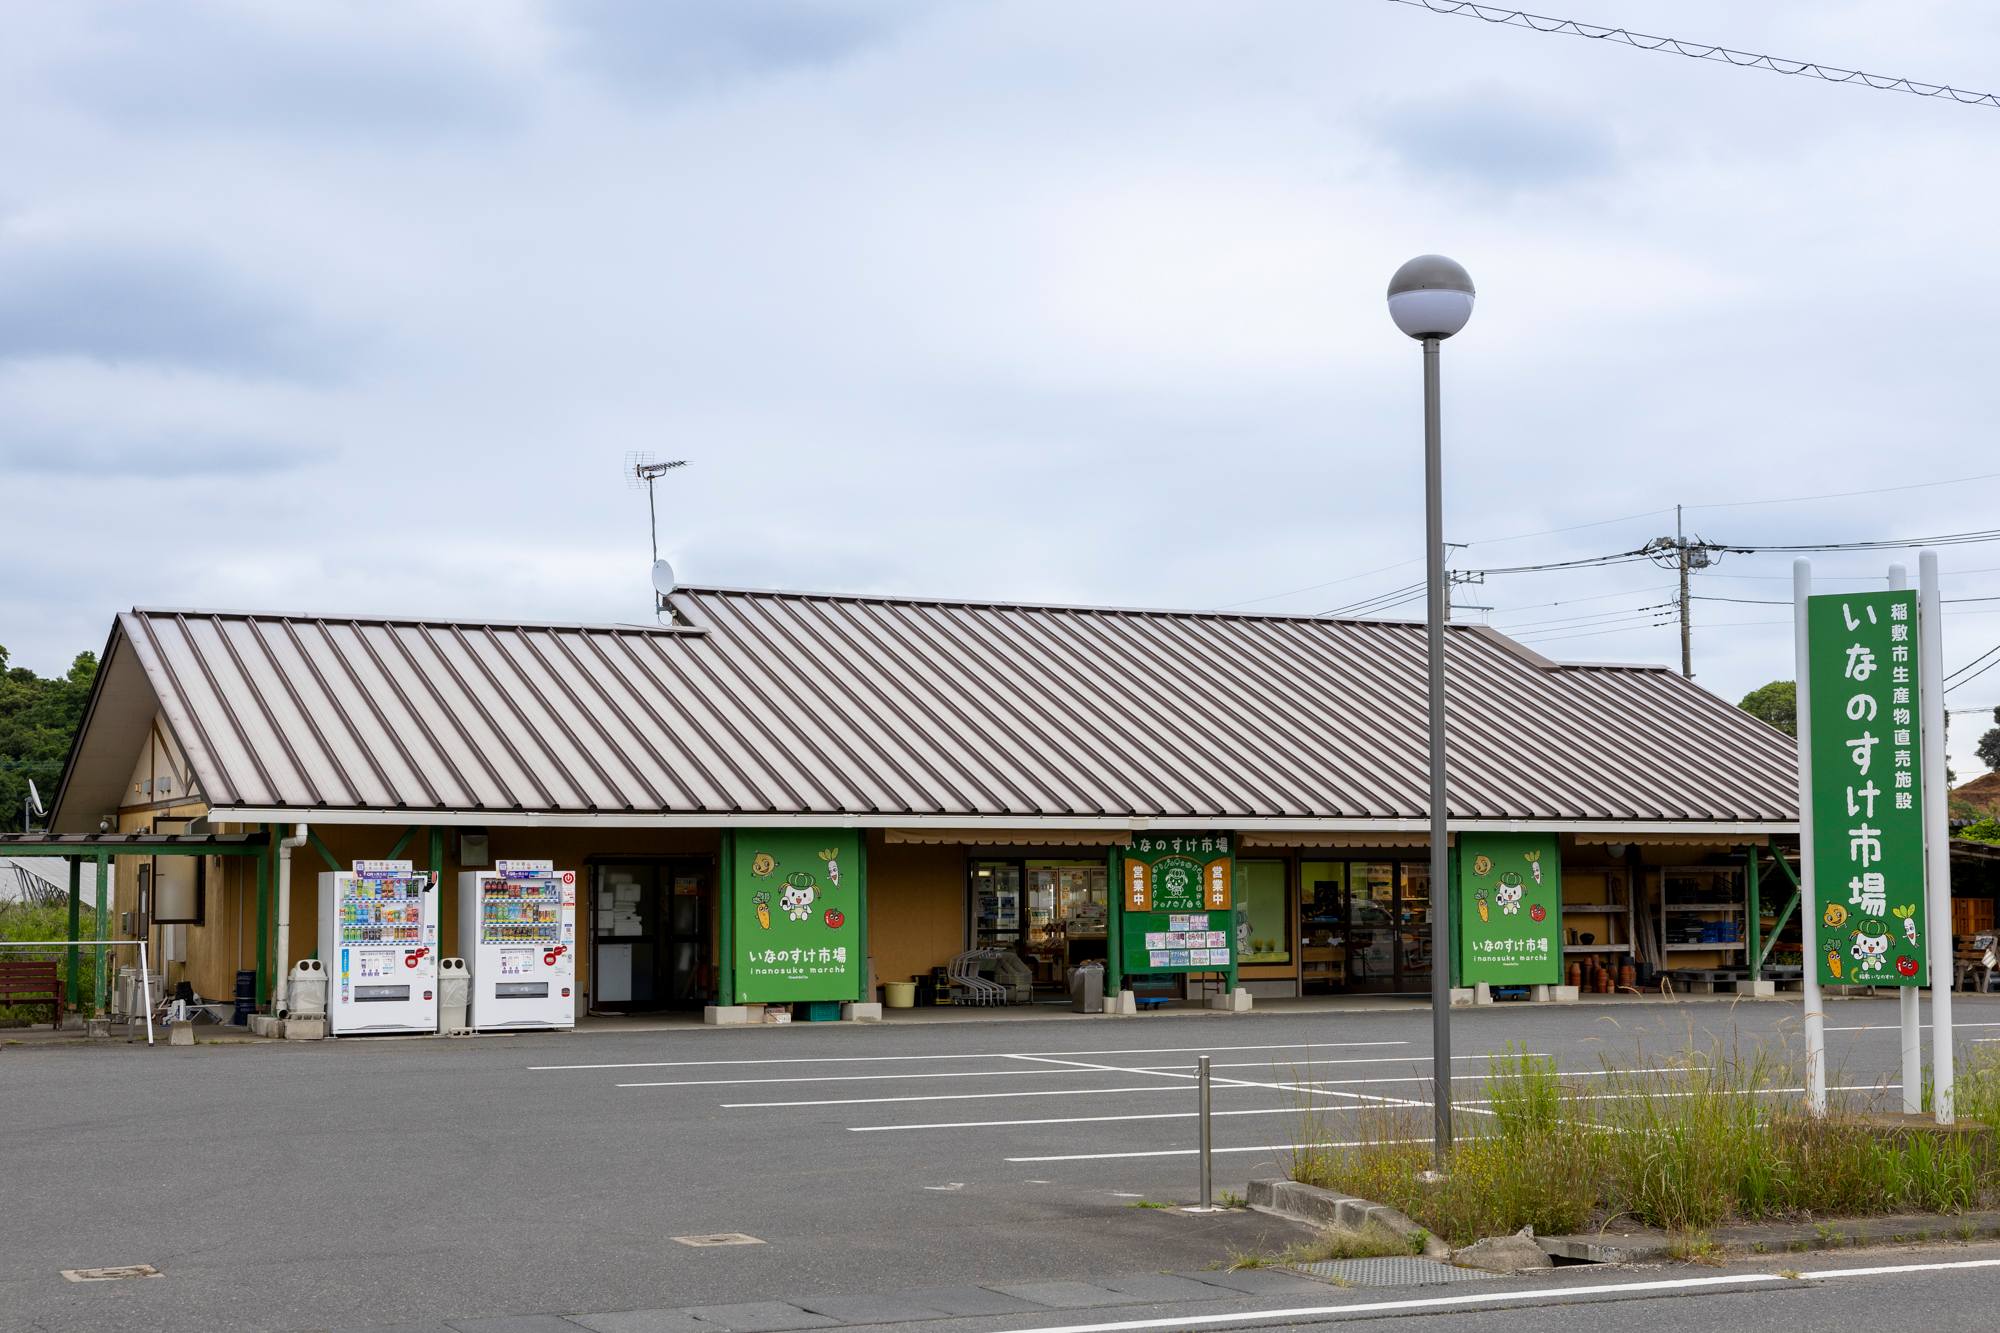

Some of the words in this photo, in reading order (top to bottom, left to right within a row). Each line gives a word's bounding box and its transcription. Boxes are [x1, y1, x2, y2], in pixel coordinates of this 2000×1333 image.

[1890, 602, 1912, 810] 稲敷市生産物直売施設
[1843, 602, 1887, 917] いなのすけ市場
[1125, 837, 1228, 853] いなのすけ市場
[1133, 865, 1144, 905] 営業中
[1212, 865, 1224, 905] 営業中
[1472, 937, 1548, 953] いなのすけ市場
[749, 946, 847, 964] いなのすけ市場
[1473, 954, 1515, 962] inanosuke
[750, 966, 804, 975] inanosuke
[809, 964, 845, 974] marché
